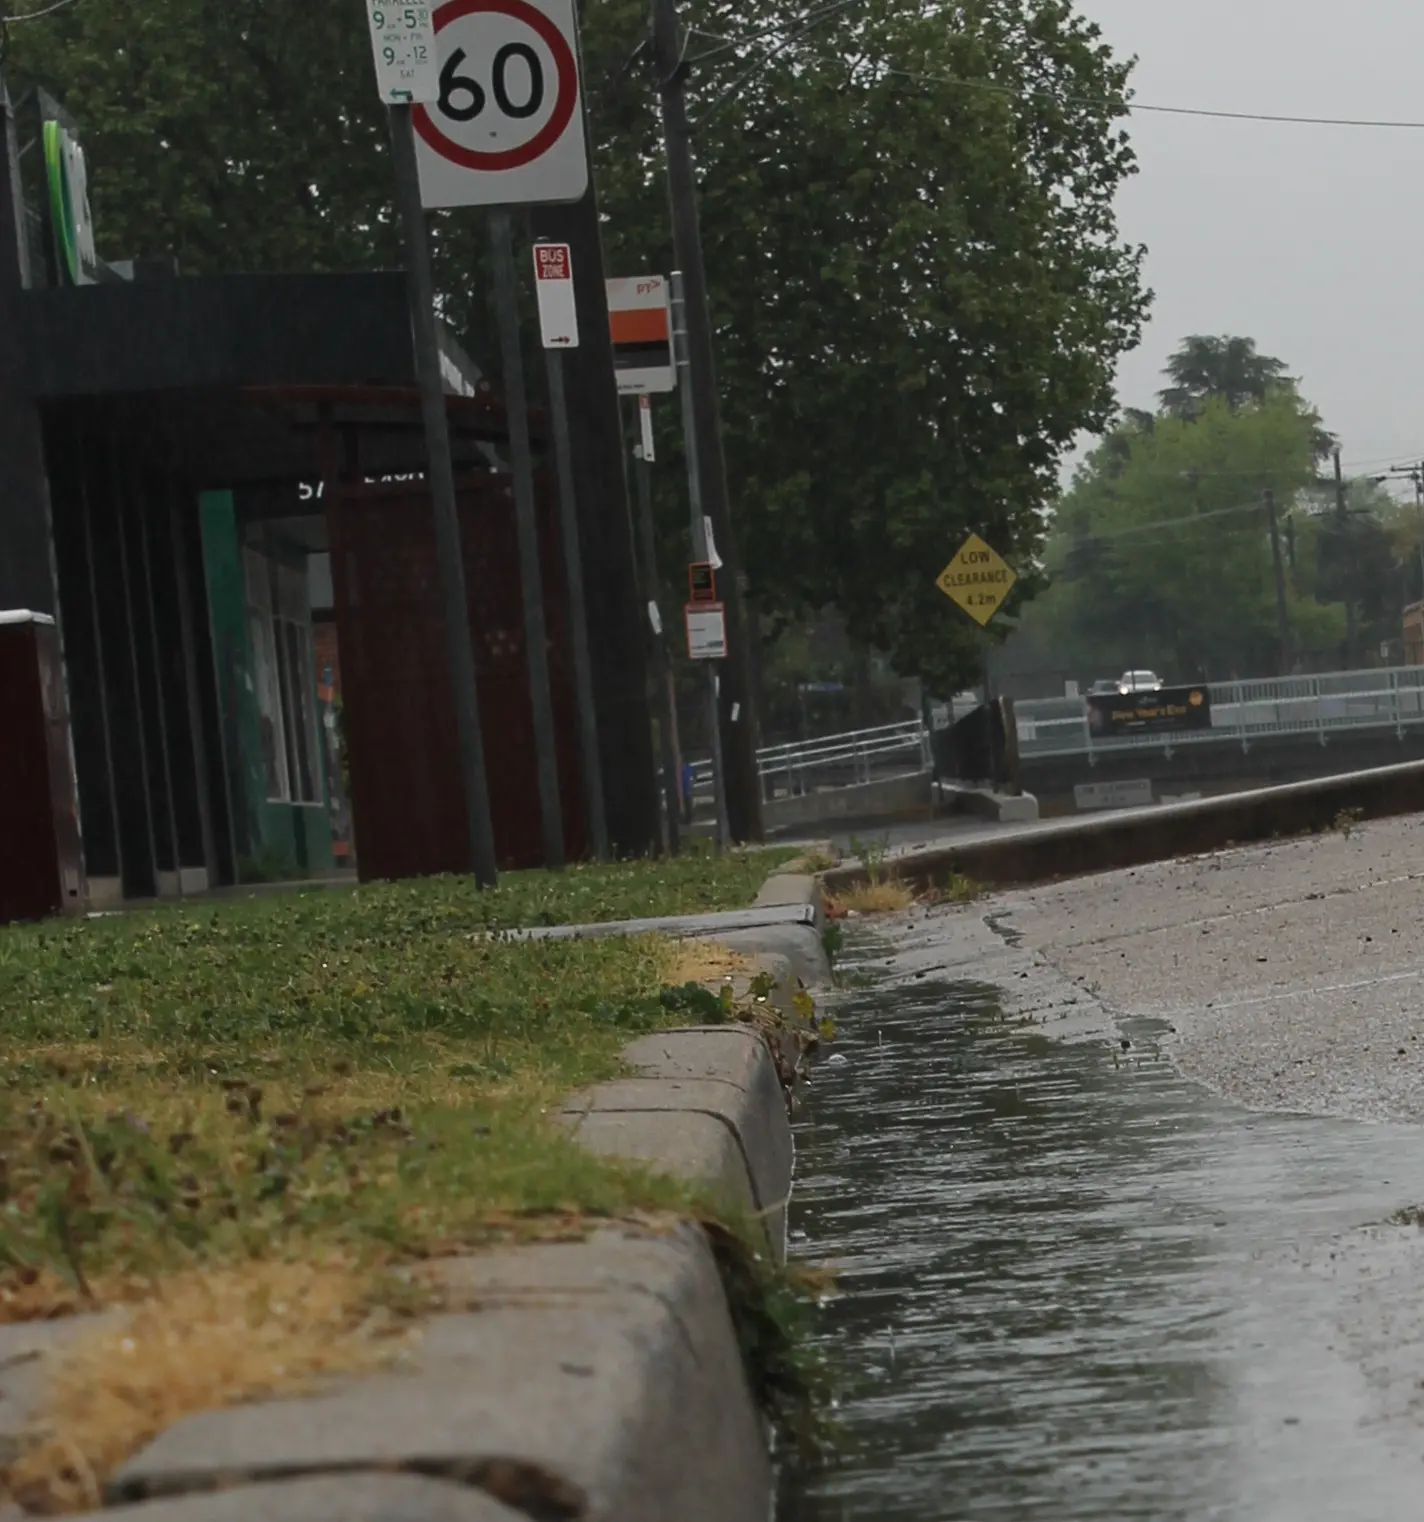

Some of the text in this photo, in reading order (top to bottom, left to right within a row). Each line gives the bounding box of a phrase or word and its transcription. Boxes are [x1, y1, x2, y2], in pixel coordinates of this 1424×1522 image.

[437, 42, 544, 121] 60
[540, 249, 564, 263] BUS
[542, 263, 566, 278] ZONE
[961, 551, 991, 565] LOW
[943, 568, 1009, 588] CLEARANCE
